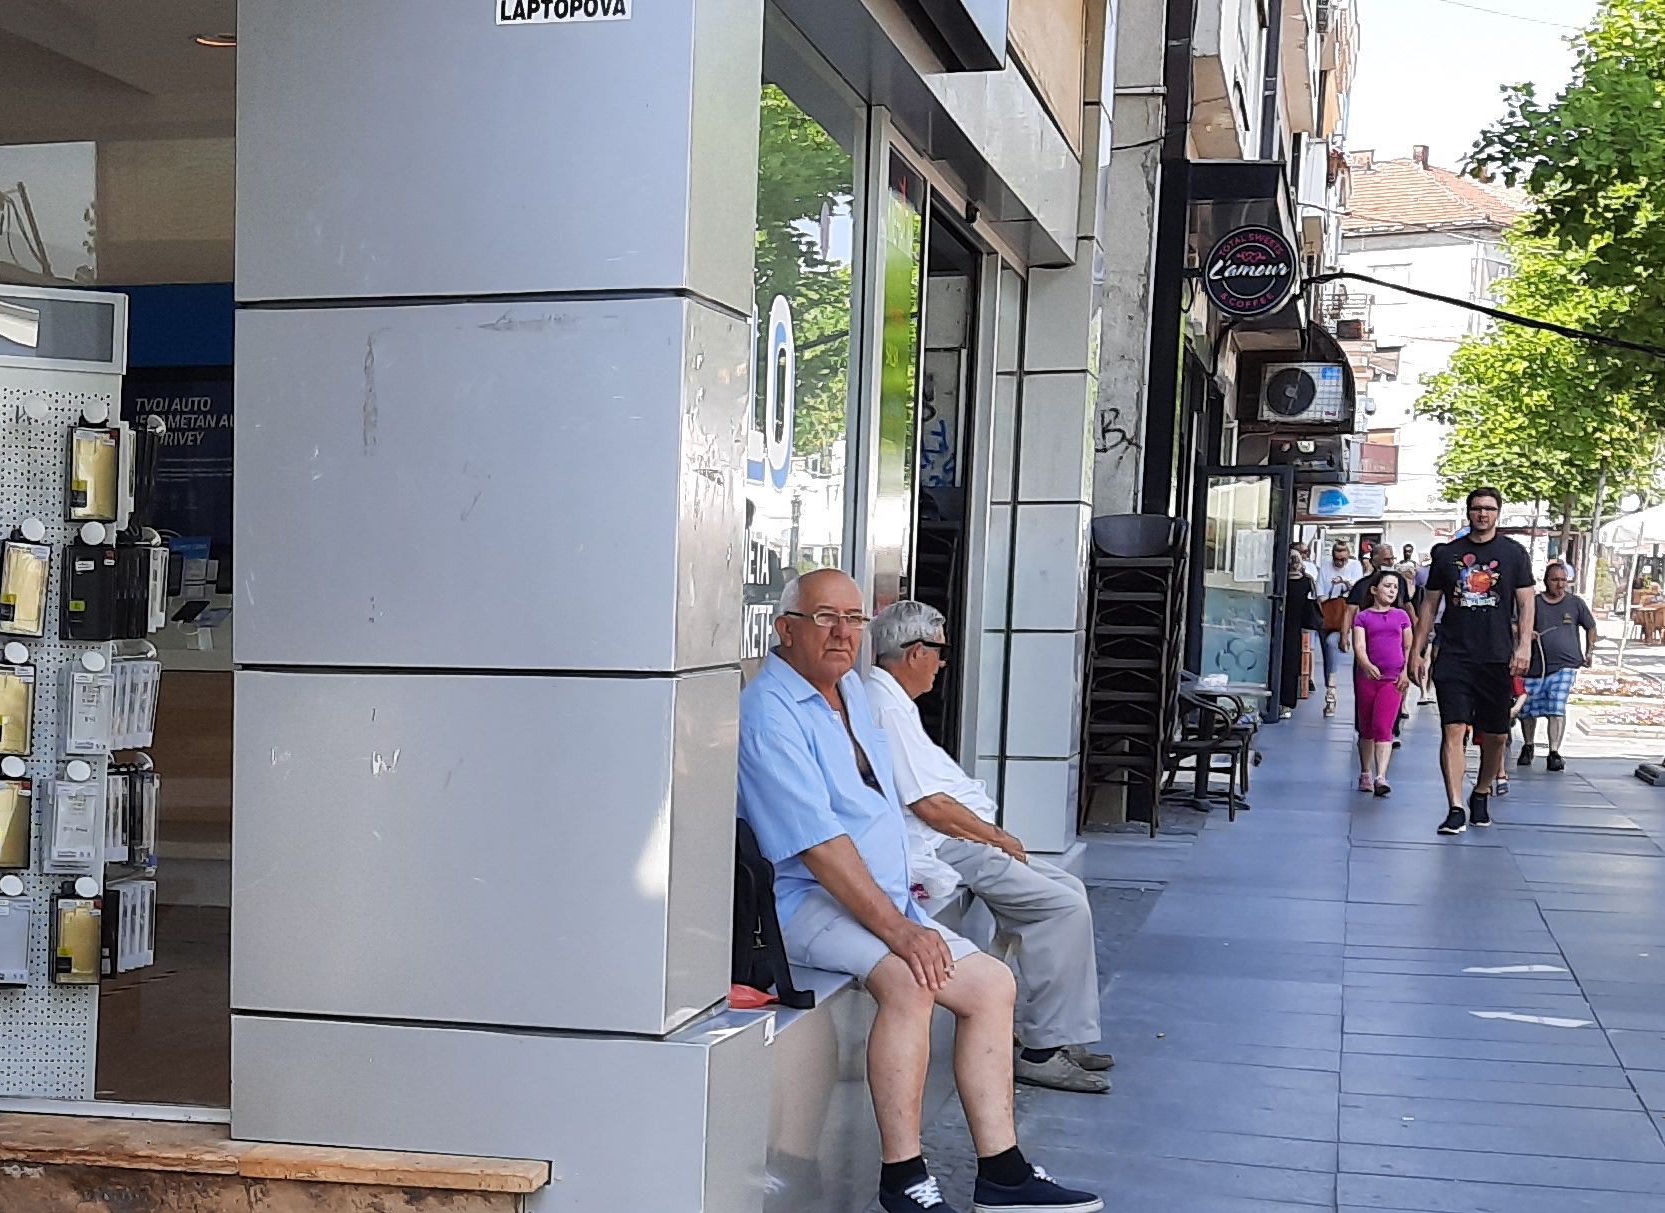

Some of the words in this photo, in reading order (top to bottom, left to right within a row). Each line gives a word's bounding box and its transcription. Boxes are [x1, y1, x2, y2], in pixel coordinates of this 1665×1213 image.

[500, 0, 626, 21] LAPTOPOVA
[1219, 236, 1246, 256] TOTAL
[1248, 233, 1284, 255] SWEETS
[1229, 292, 1275, 308] COFFEE
[135, 398, 169, 412] TVOJ
[171, 397, 211, 412] AUTO
[163, 414, 216, 429] METAN
[742, 529, 770, 585] ETA
[740, 604, 774, 660] KETE
